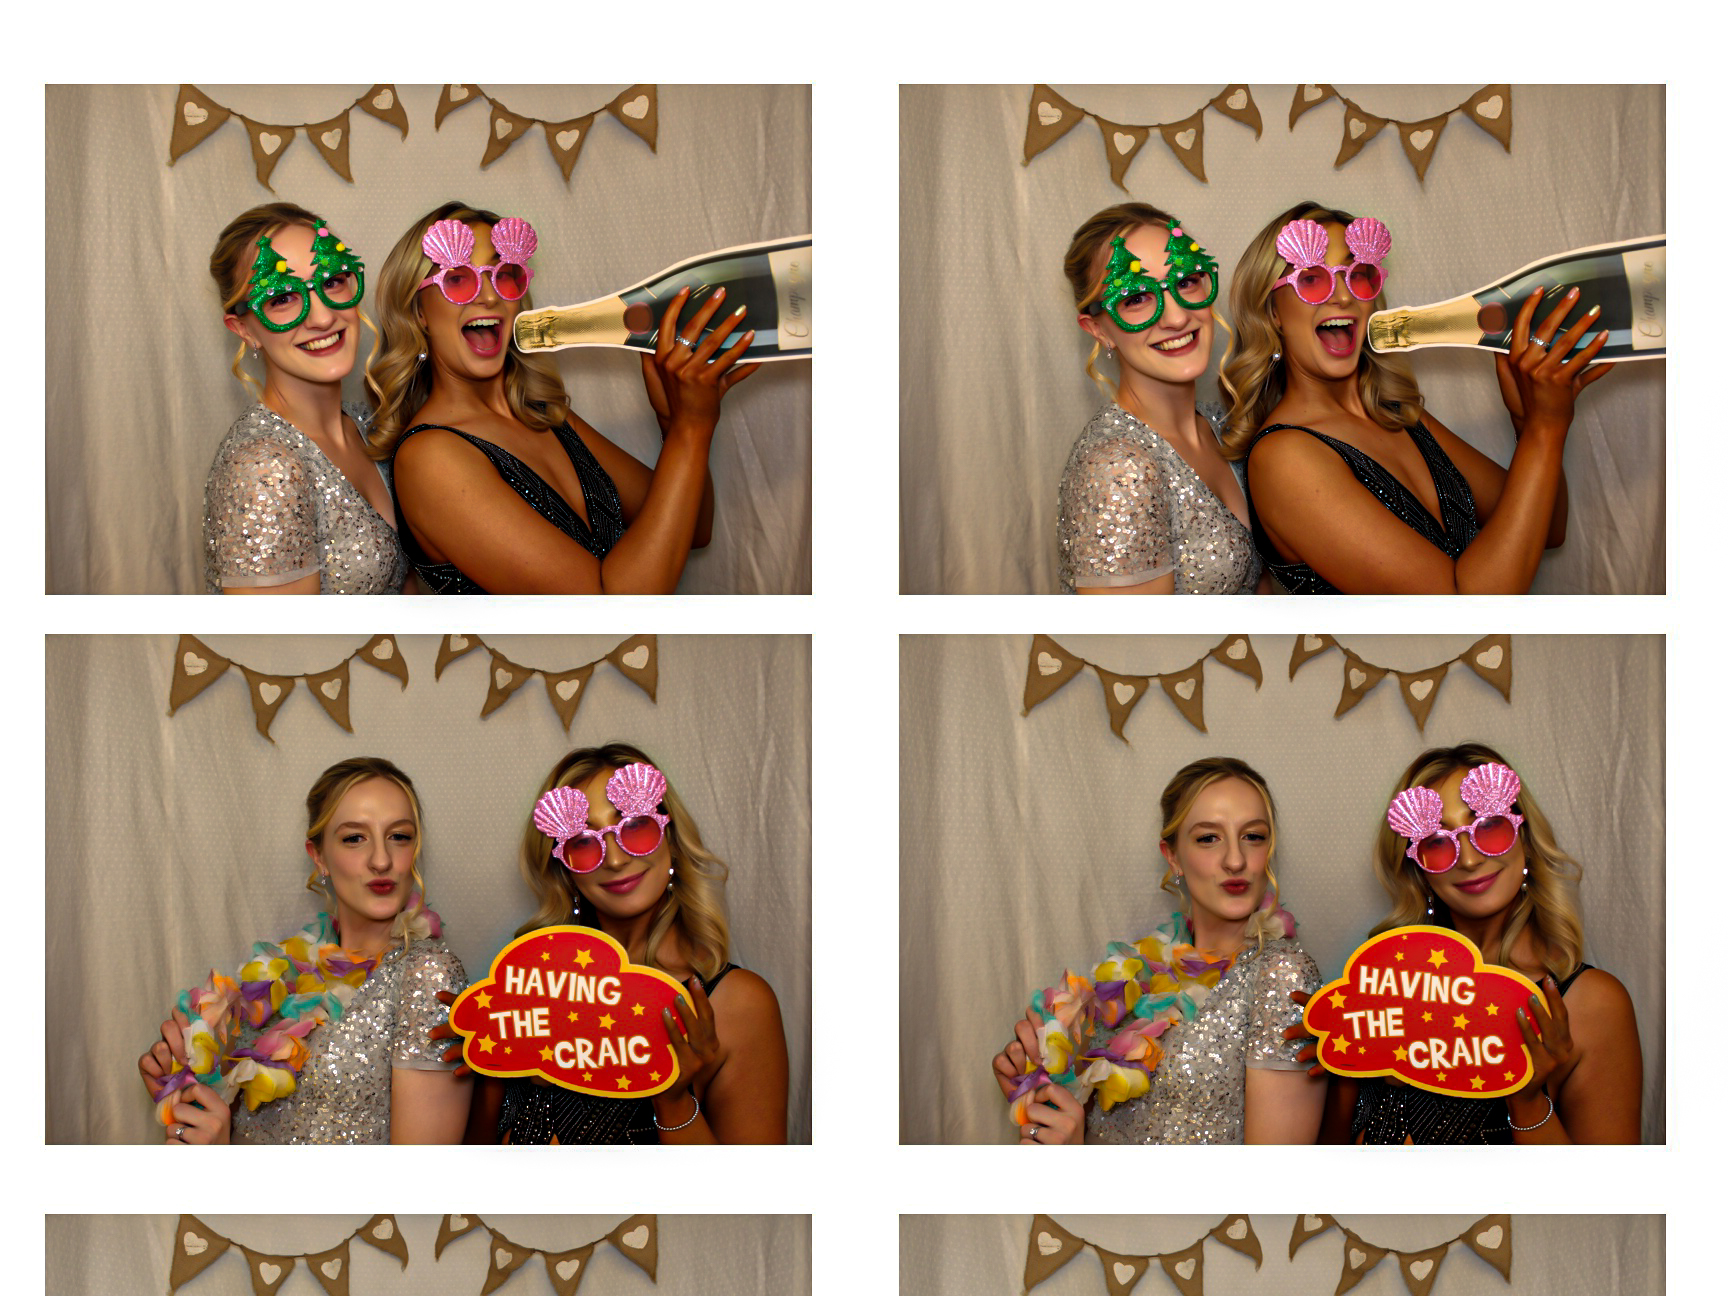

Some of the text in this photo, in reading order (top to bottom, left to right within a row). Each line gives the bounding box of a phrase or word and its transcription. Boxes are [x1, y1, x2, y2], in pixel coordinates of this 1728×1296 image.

[784, 261, 809, 338] Champgne
[1638, 261, 1663, 338] Champgne
[505, 965, 622, 1005] HAVING
[1359, 965, 1476, 1005] HAVING
[489, 1007, 551, 1040] THE
[1343, 1007, 1405, 1040] THE
[554, 1035, 651, 1069] CRAIC
[1408, 1035, 1505, 1069] CRAIC
